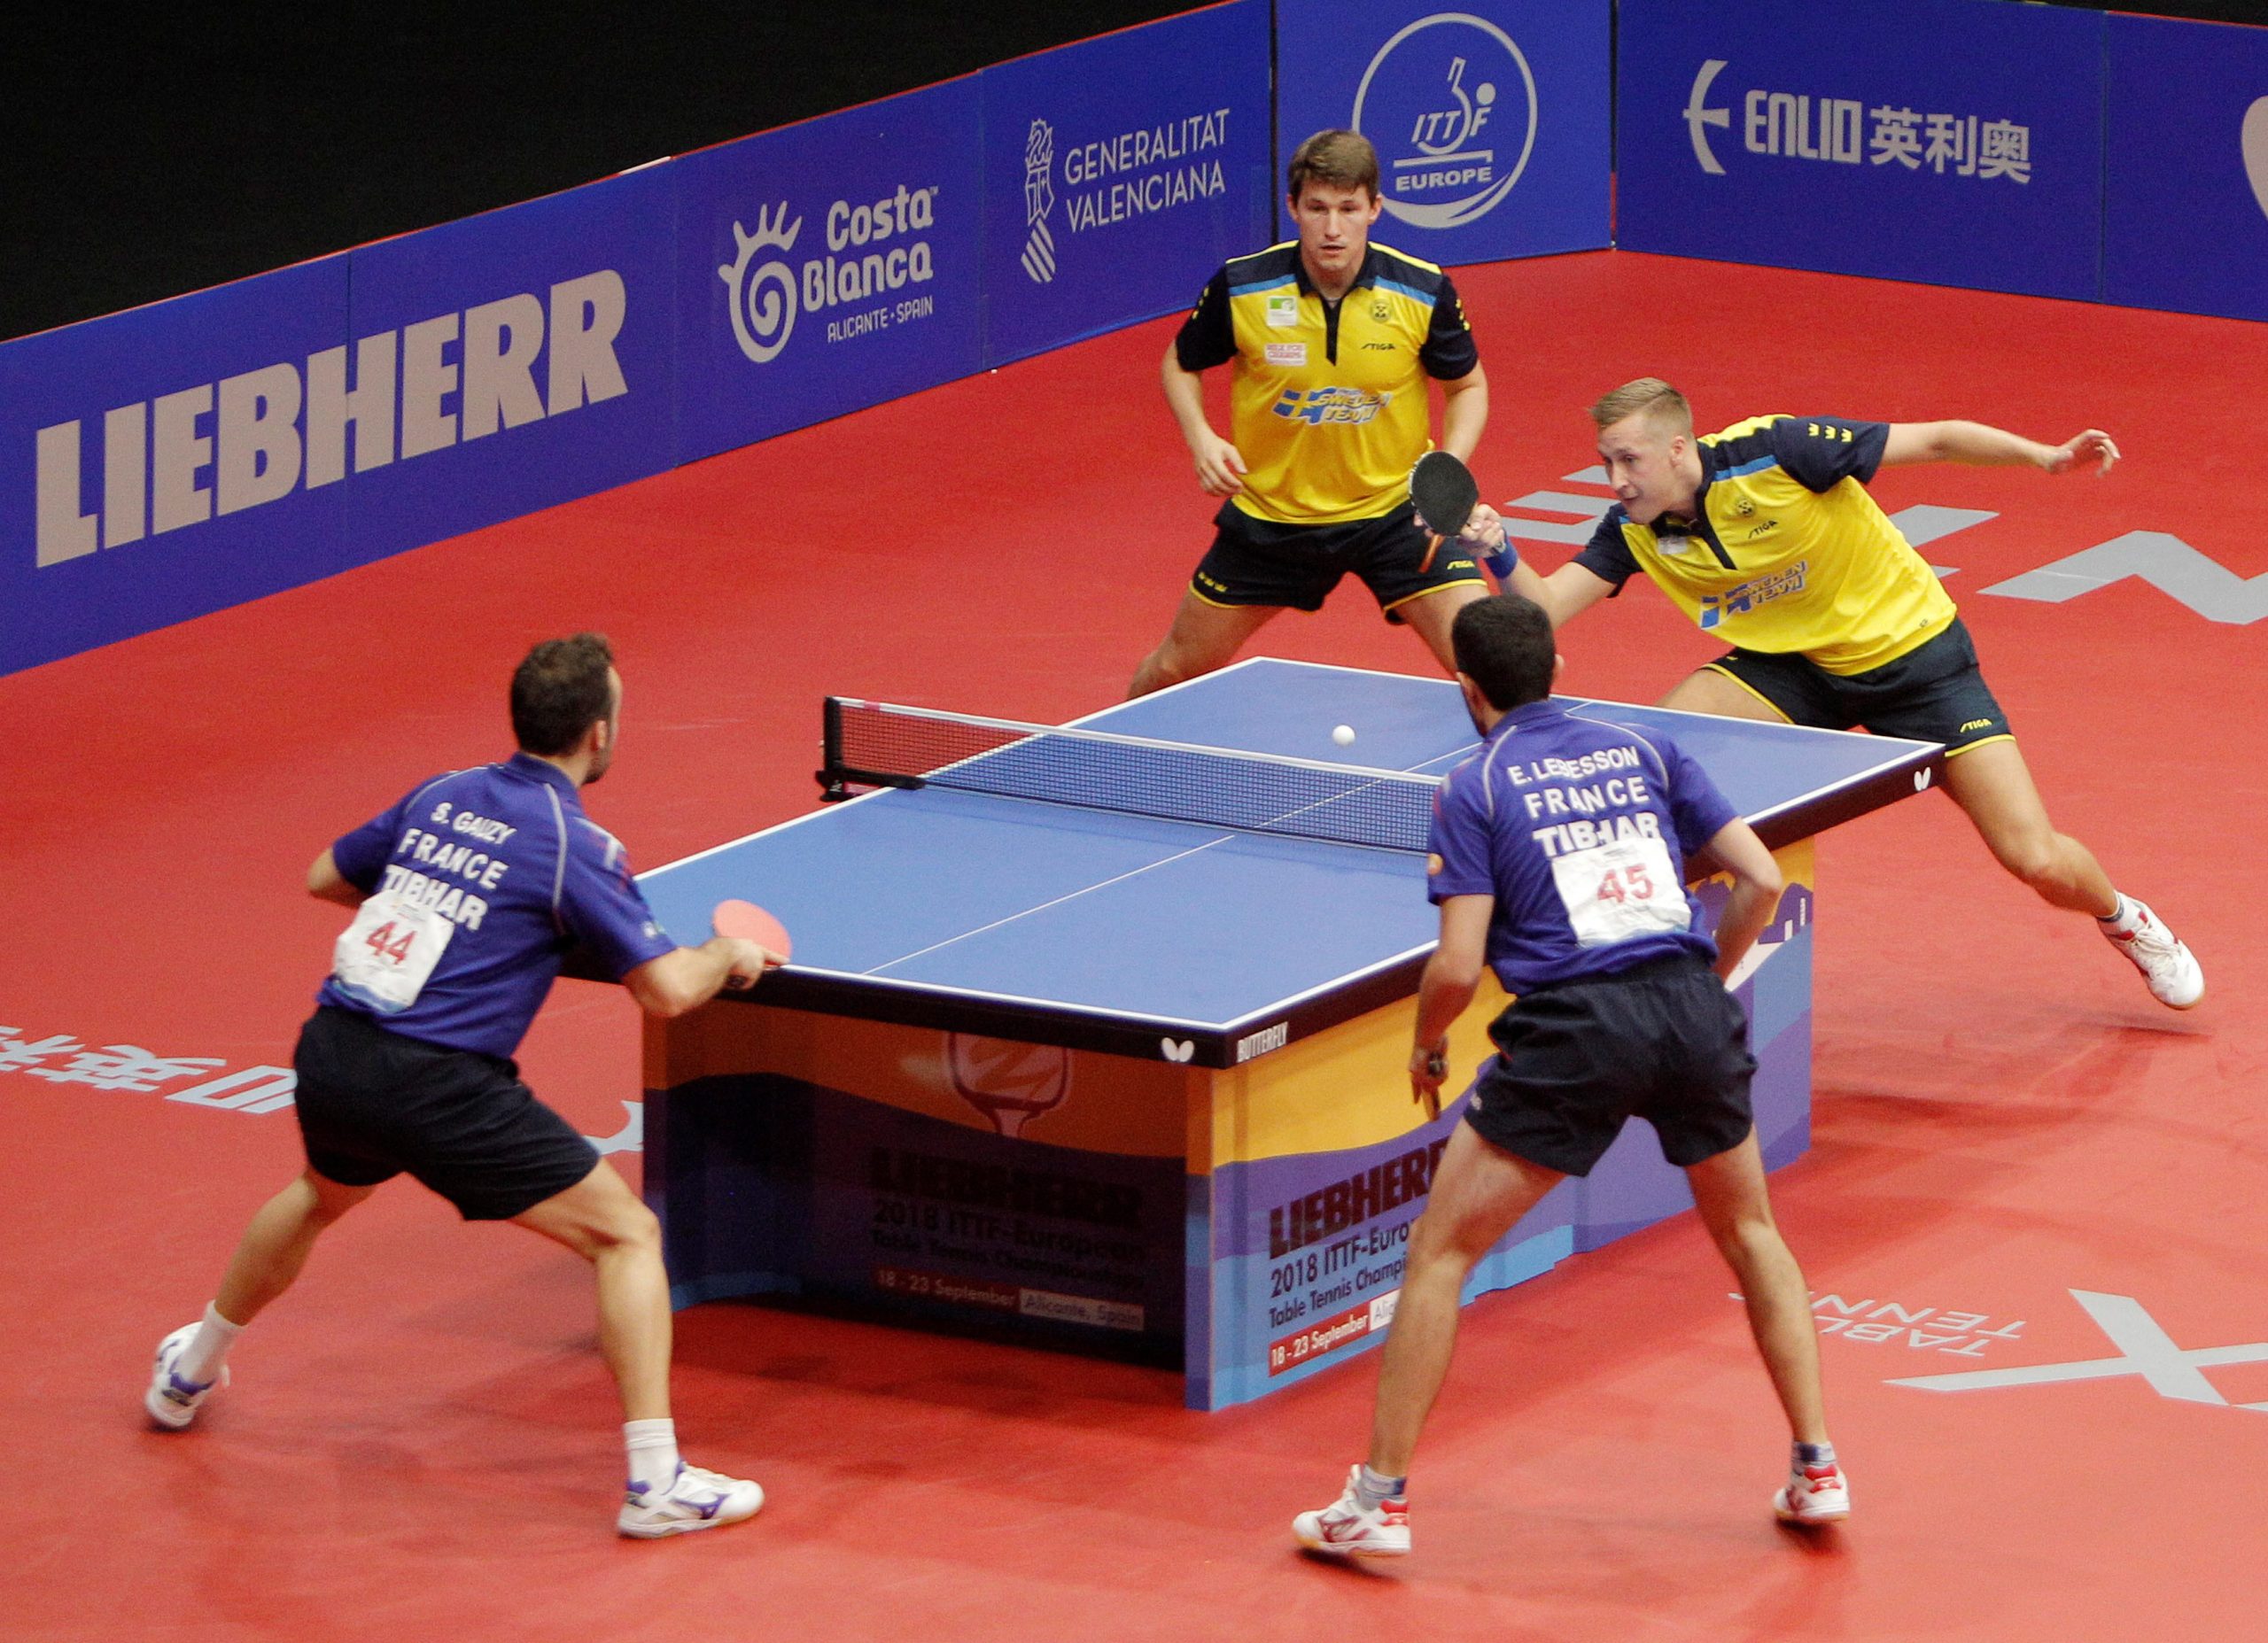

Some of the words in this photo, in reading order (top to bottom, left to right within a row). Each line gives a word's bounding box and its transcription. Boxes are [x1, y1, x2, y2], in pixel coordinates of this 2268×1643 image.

[1065, 107, 1230, 185] GENERALITAT
[1411, 106, 1492, 143] ITTF
[1744, 89, 1862, 164] ENLIO
[1869, 105, 2031, 184] 英利奥
[1066, 159, 1226, 233] VALENCIANA
[1395, 167, 1493, 191] EUROPE
[827, 183, 934, 252] Costa
[803, 241, 934, 312] Blanca
[827, 307, 888, 344] ALICANTE
[897, 295, 933, 324] SPAIN
[1361, 342, 1396, 351] STIGA
[36, 269, 628, 569] LIEBHERR
[1749, 520, 1778, 539] STIGA
[1960, 717, 1992, 733] STIGA
[1508, 765, 1533, 786] E.
[1531, 746, 1641, 780] LEBESSON
[1524, 776, 1651, 819] FRANCE
[431, 802, 453, 825] S.
[453, 811, 518, 844] GAUZY
[1532, 811, 1661, 857] TIBHAR
[397, 827, 510, 889] FRANCE
[383, 864, 488, 931] TIBHAR
[1596, 864, 1654, 903] 45
[365, 921, 417, 965] 44
[1237, 1021, 1288, 1063] BUTTERFLY
[1270, 1252, 1318, 1298] 2018
[1324, 1220, 1410, 1275] ITTF-Euro
[909, 1274, 930, 1294] 23
[934, 1279, 1016, 1307] September
[1270, 1297, 1307, 1329] Table
[1310, 1278, 1352, 1311] Tennis
[1355, 1252, 1407, 1290] Champi
[1728, 1290, 2027, 1339] TENN
[1814, 1315, 1991, 1357] TABL
[1271, 1345, 1285, 1368] 18
[1293, 1335, 1309, 1359] 23
[1311, 1314, 1370, 1350] September
